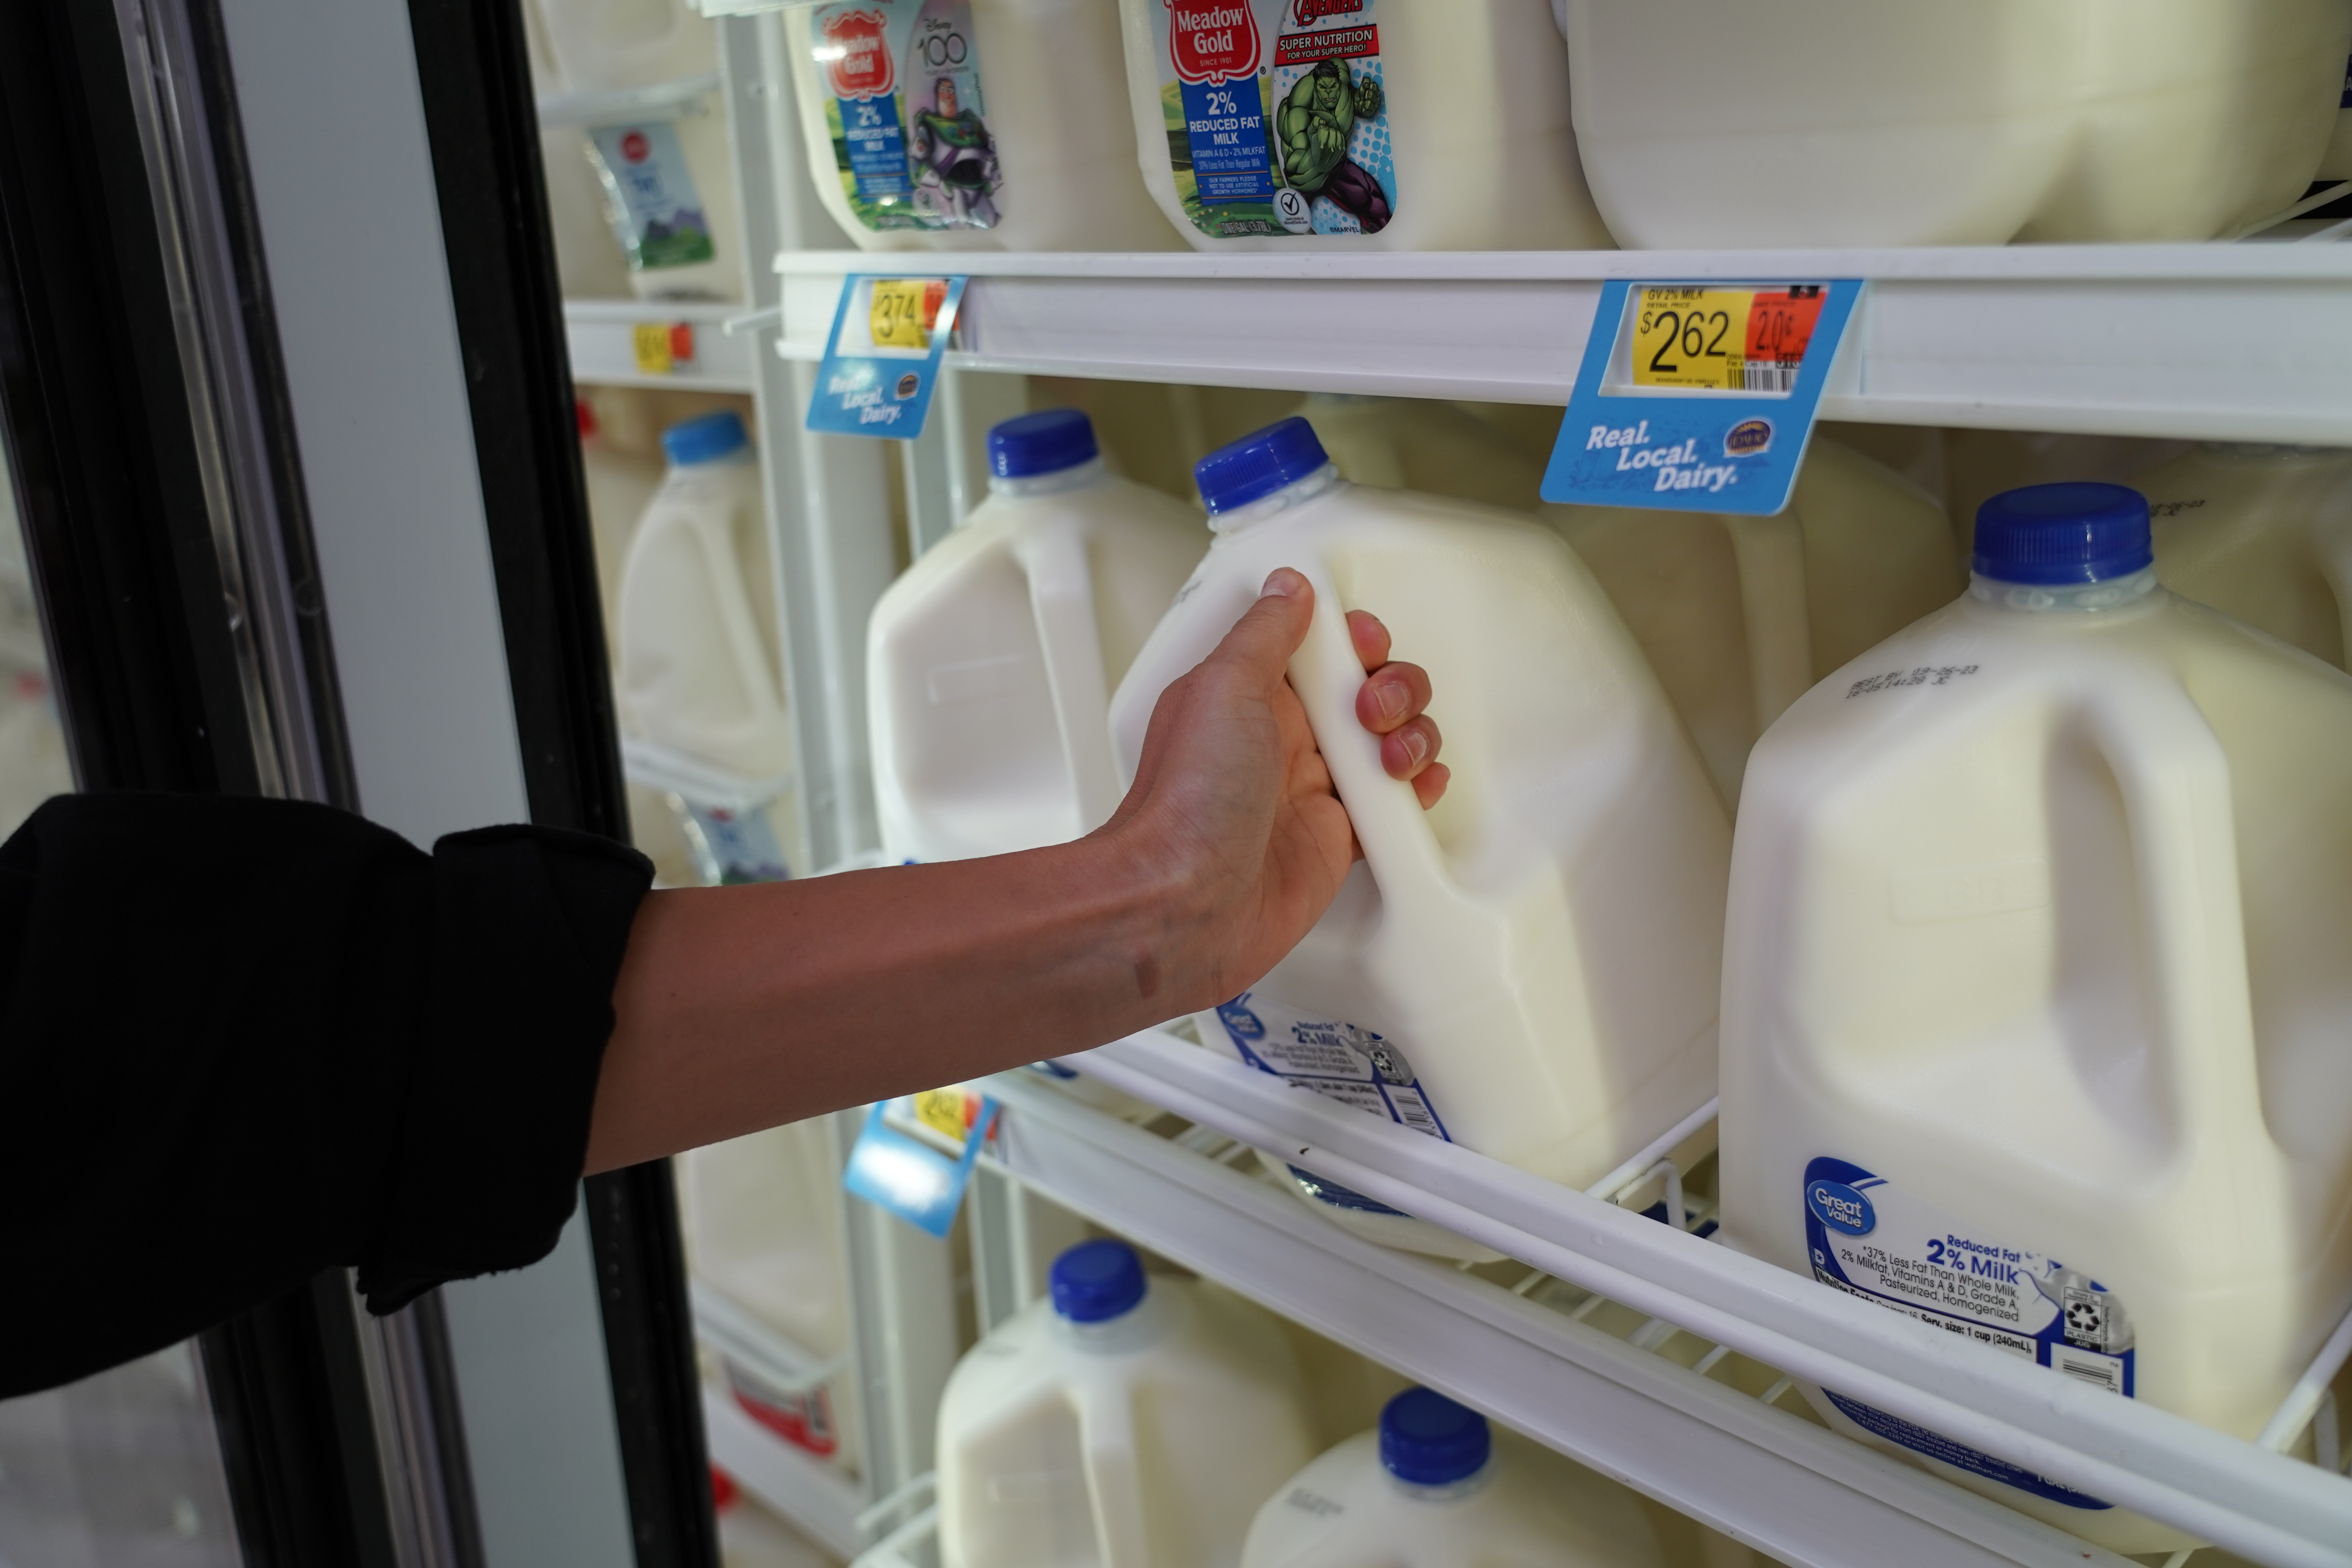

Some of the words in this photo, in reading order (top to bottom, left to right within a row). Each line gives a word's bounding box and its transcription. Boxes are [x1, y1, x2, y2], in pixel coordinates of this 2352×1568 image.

[1176, 6, 1244, 33] Meadow
[918, 33, 967, 67] 100
[1194, 30, 1234, 54] Gold
[1279, 36, 1311, 51] SUPER
[1314, 29, 1372, 47] NUTRITION
[1287, 51, 1300, 60] FOR
[1301, 49, 1320, 58] YOUR
[1321, 47, 1342, 56] SUPER
[1344, 44, 1367, 53] HERO!
[1206, 91, 1237, 115] 2%
[1189, 118, 1238, 132] REDUCED
[1240, 116, 1260, 129] FAT
[1191, 150, 1214, 158] VITAMIN
[1233, 148, 1241, 156] 2%
[1242, 146, 1265, 155] MILKFAT
[1213, 132, 1240, 145] MILK
[1648, 289, 1663, 300] GV
[1664, 289, 1678, 300] 2%
[1680, 289, 1704, 300] MILK
[1586, 420, 1650, 450] Real.
[1616, 438, 1698, 471] Local.
[1654, 462, 1738, 493] Dairy.
[1849, 675, 1882, 691] BEST
[1884, 670, 1903, 682] BY
[1815, 1187, 1862, 1218] Great
[1826, 1205, 1862, 1228] Value
[1926, 1238, 1965, 1270] 2%
[1971, 1255, 2018, 1285] Milk
[1947, 1234, 1999, 1258] Reduced
[2002, 1248, 2020, 1263] Fat
[1842, 1249, 1854, 1262] 2%
[1857, 1254, 1889, 1276] Milkfat,
[1891, 1265, 1934, 1287] Vitamins
[1937, 1279, 1944, 1290] A
[1947, 1282, 1955, 1293] &
[1958, 1285, 1967, 1298] D,
[1971, 1288, 2005, 1306] Grade
[2009, 1299, 2019, 1311] A,
[1889, 1253, 1909, 1269] Less
[1912, 1260, 1928, 1274] Fat
[1929, 1265, 1954, 1281] Than
[1958, 1272, 1991, 1290] Whole
[1994, 1282, 2019, 1300] Milk,
[1880, 1274, 1940, 1302] Pasteurized,
[1943, 1294, 2018, 1322] Homogenized
[1945, 1321, 1964, 1334] size:
[1967, 1327, 1971, 1336] 1
[1974, 1329, 1991, 1343] cup
[1993, 1333, 2032, 1354] (240mL),
[2067, 1330, 2098, 1342] PLASTIC
